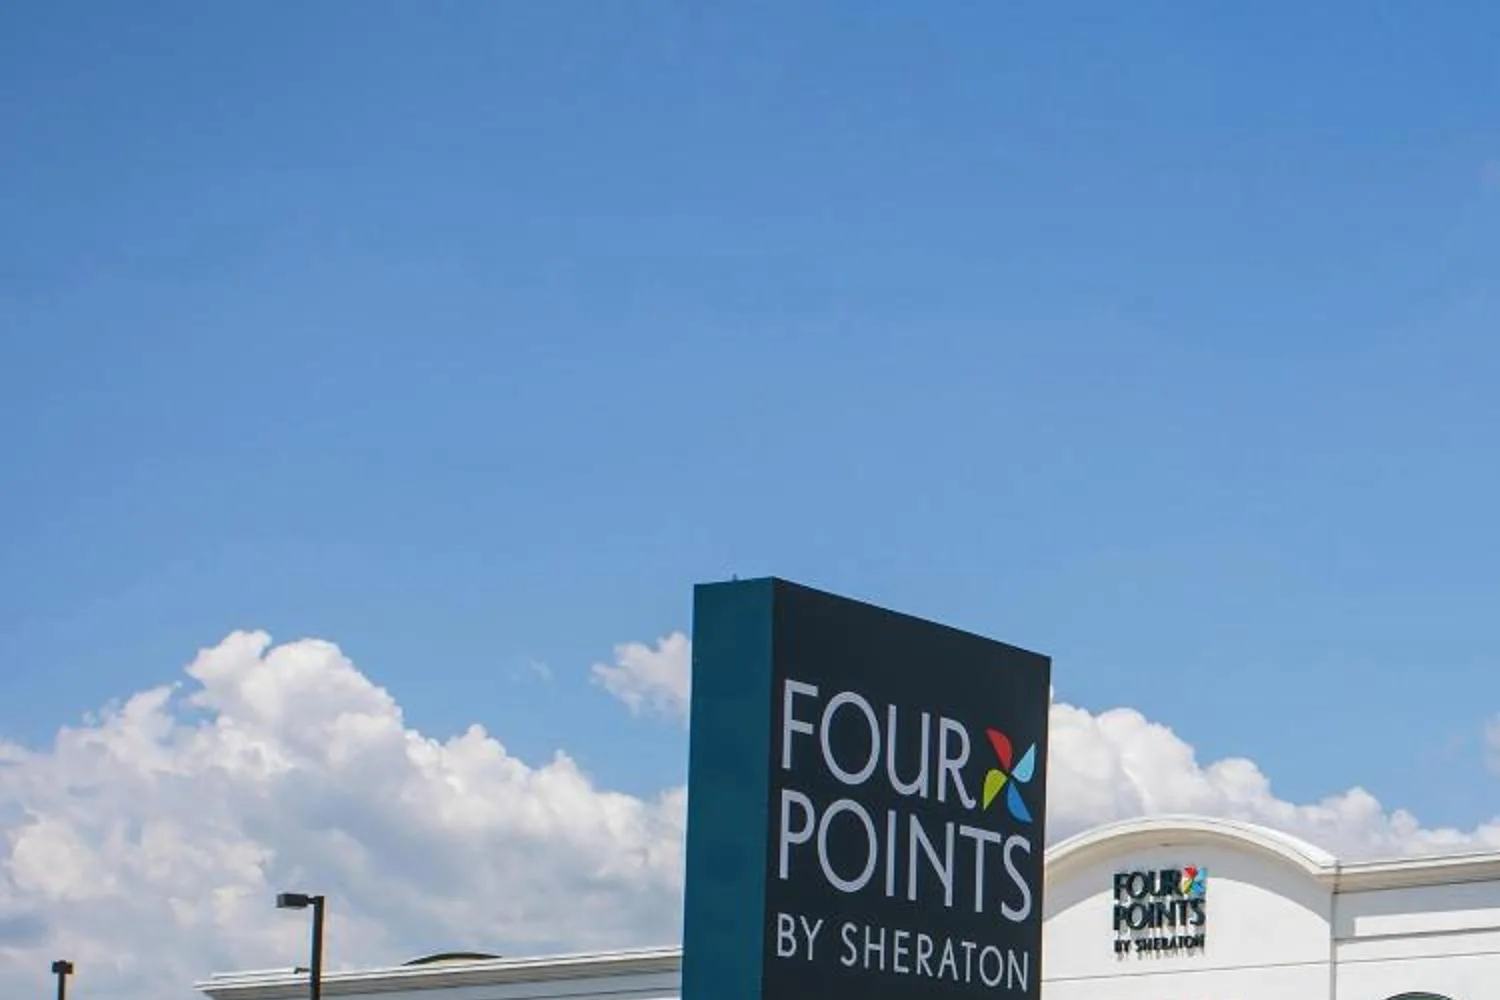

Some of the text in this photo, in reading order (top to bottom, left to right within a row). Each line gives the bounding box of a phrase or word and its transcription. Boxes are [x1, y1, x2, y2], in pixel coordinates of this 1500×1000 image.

[782, 678, 977, 810] FOUR
[779, 788, 1032, 923] POINTS
[1113, 869, 1183, 900] FOUR
[1113, 898, 1206, 930] POINTS
[776, 912, 1030, 992] BY SHERATON
[1114, 934, 1205, 953] BY SHERATON
